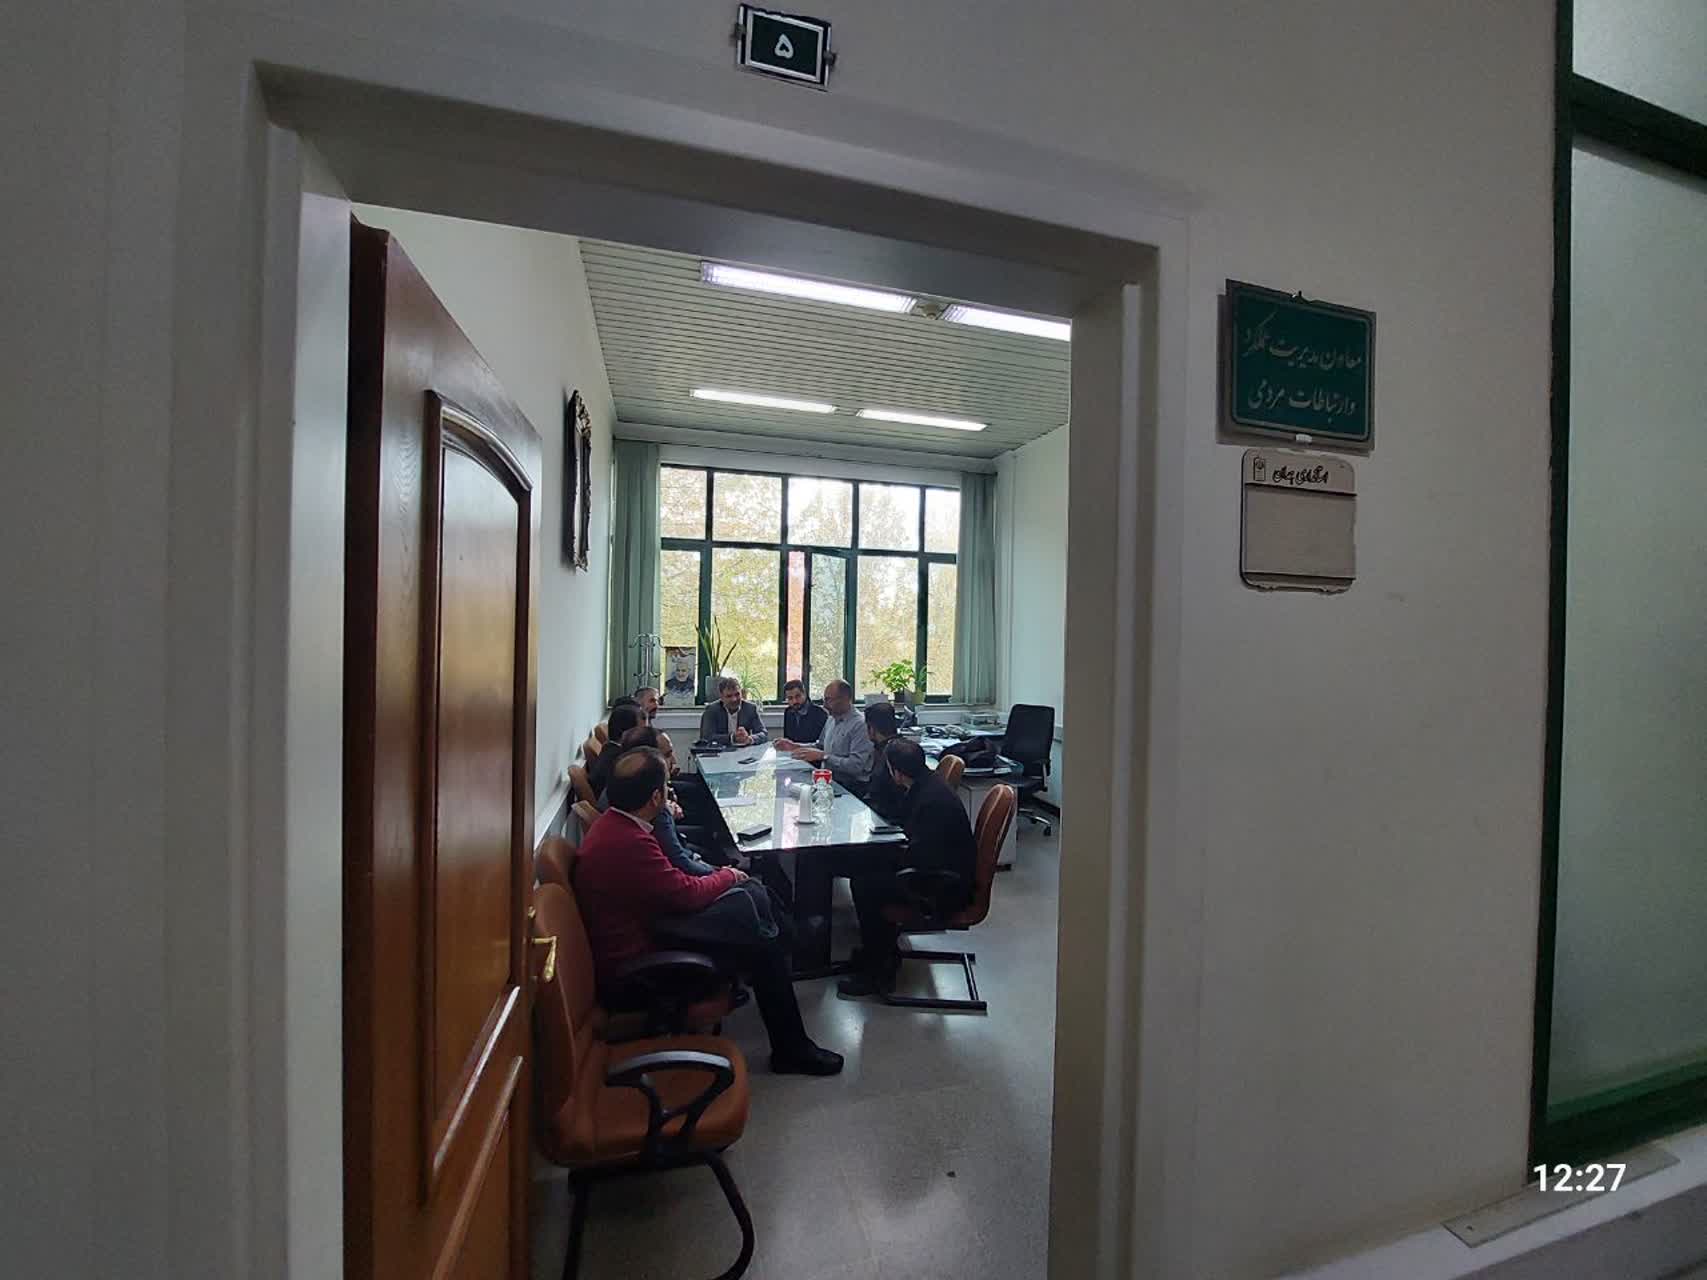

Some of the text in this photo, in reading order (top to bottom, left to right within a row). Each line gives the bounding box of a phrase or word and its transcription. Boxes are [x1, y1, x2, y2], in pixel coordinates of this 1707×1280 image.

[775, 33, 794, 59] ۵
[1269, 337, 1319, 369] مدیریت
[1248, 379, 1285, 409] مردمی
